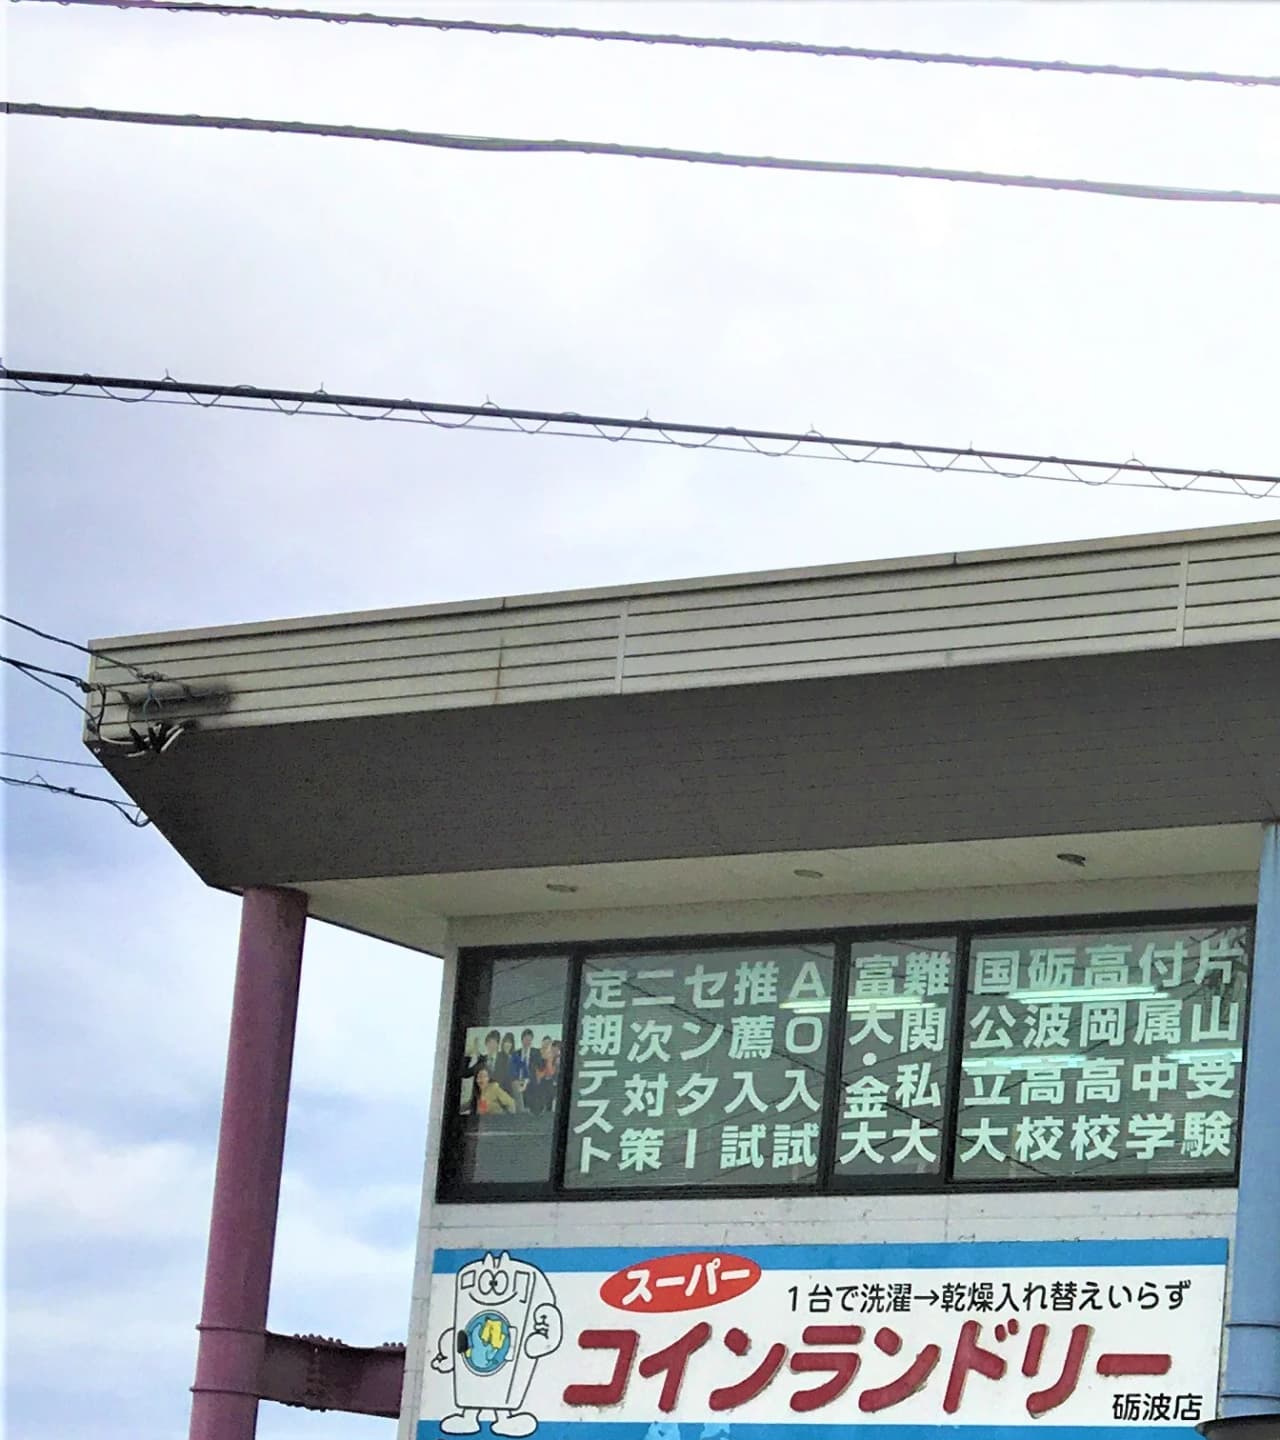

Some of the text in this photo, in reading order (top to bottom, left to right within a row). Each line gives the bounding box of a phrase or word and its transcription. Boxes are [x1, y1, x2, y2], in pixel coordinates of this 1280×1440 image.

[573, 968, 627, 1174] 定期テスト
[617, 968, 676, 1173] 二次対策
[719, 960, 780, 1171] 推薦入試
[839, 954, 900, 1165] 富大・金大
[890, 950, 952, 1164] 難関私大
[960, 948, 1022, 1163] 国公立大
[1014, 946, 1077, 1162] 砺波高校
[1070, 943, 1133, 1160] 高岡高校
[1126, 939, 1188, 1160] 付属中学
[1180, 935, 1246, 1159] 片山受験
[562, 1319, 1173, 1418] コインランドリー
[622, 1265, 753, 1305] スーパー
[1110, 1391, 1203, 1422] 砺波店
